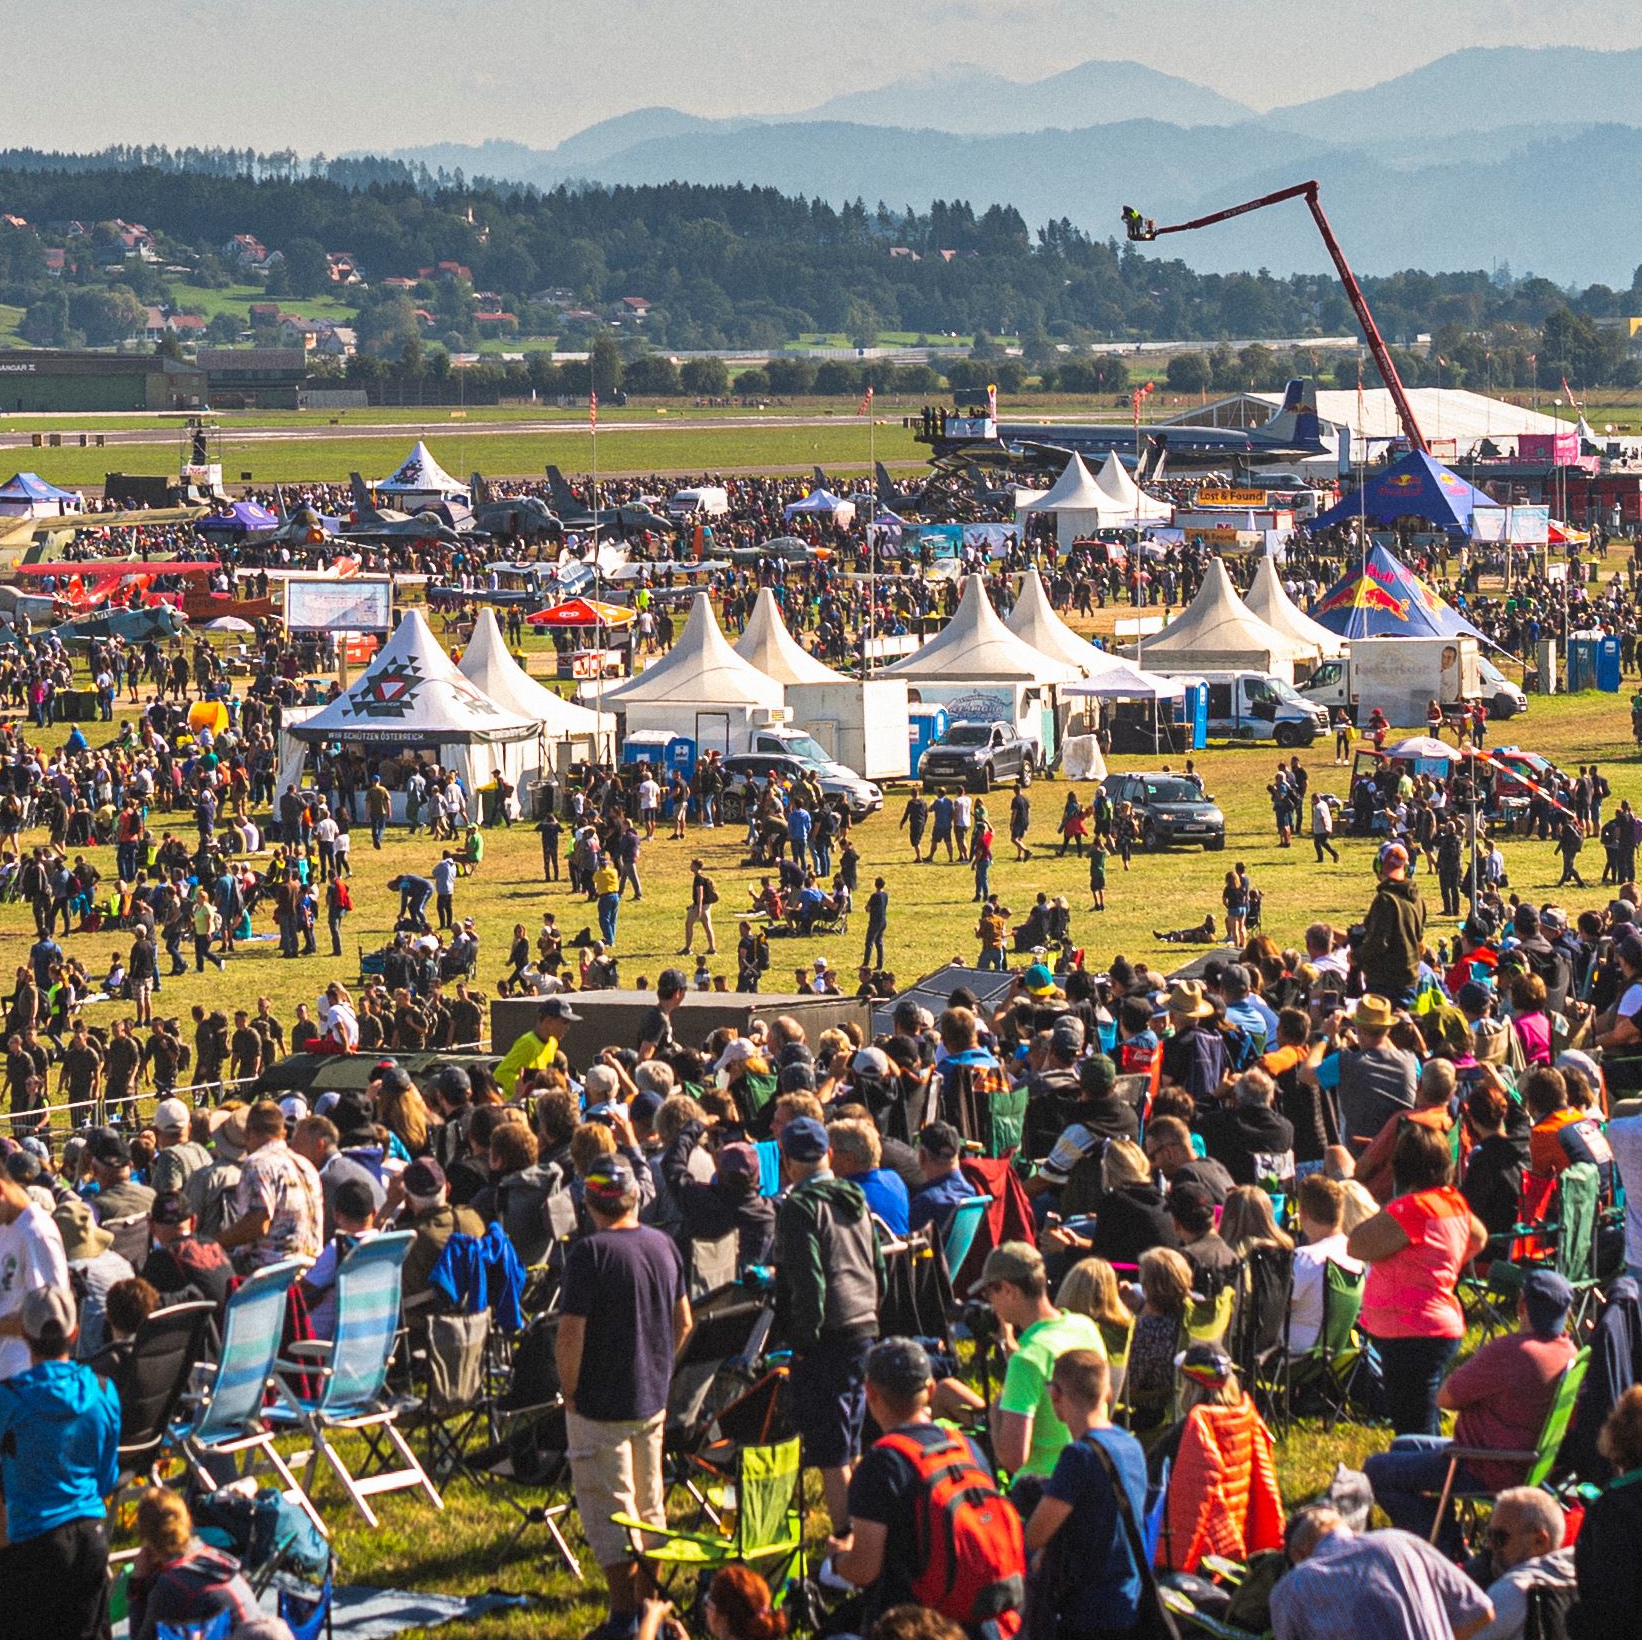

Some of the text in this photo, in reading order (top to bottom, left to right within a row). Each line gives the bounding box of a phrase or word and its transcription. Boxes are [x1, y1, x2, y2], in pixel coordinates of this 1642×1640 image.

[1200, 491, 1263, 501] Lost & Found
[343, 730, 379, 740] SCHÜTZEN
[380, 730, 424, 741] ÖSTERREICH
